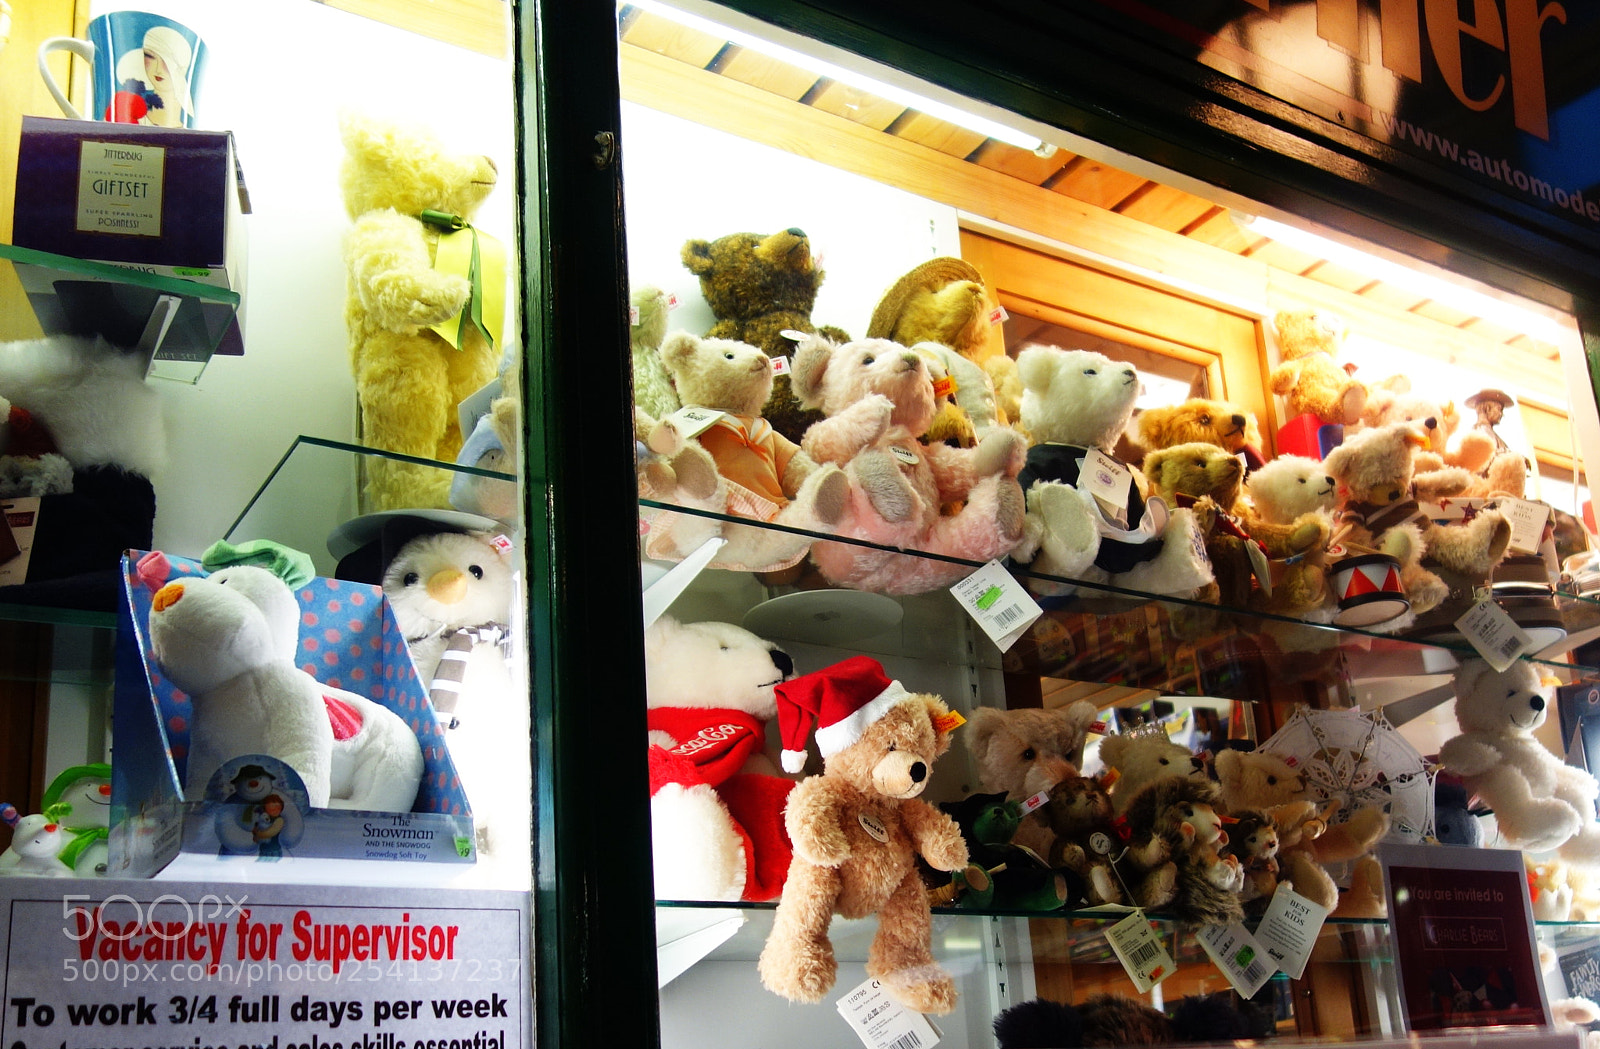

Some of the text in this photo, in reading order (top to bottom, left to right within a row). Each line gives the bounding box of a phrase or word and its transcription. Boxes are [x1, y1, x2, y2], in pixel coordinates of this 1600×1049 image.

[104, 149, 143, 161] JITTERBUG
[391, 815, 411, 827] The
[362, 823, 435, 840] Snowman
[365, 840, 431, 849] AND THE SNOWDOG
[365, 850, 398, 860] Snowdog
[415, 852, 428, 861] Toy
[1409, 886, 1431, 900] You
[1454, 887, 1491, 902] invited
[1289, 899, 1311, 916] BEST
[1283, 910, 1305, 927] KIDS
[75, 906, 459, 976] Vacancy for Supervisor
[11, 993, 508, 1029] To work 3/4 full days per week
